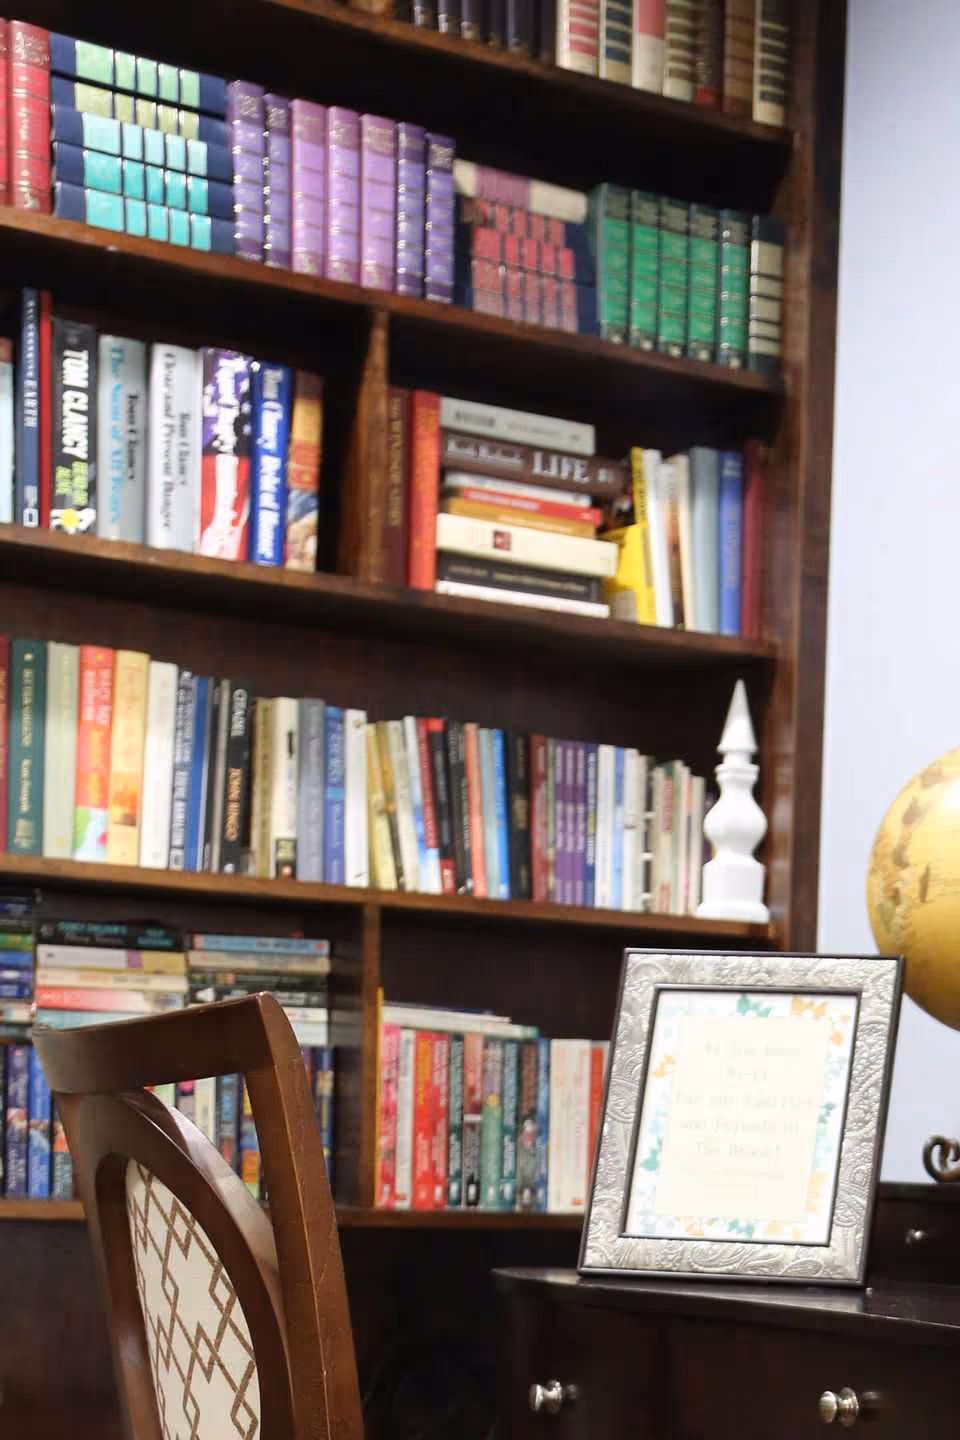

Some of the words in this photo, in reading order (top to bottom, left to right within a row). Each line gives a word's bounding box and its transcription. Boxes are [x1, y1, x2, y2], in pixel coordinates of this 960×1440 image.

[63, 349, 89, 388] TOM
[62, 389, 89, 460] CLANCY
[533, 451, 590, 484] LIFE
[231, 688, 248, 737] CITADEL
[227, 768, 241, 800] JOHN
